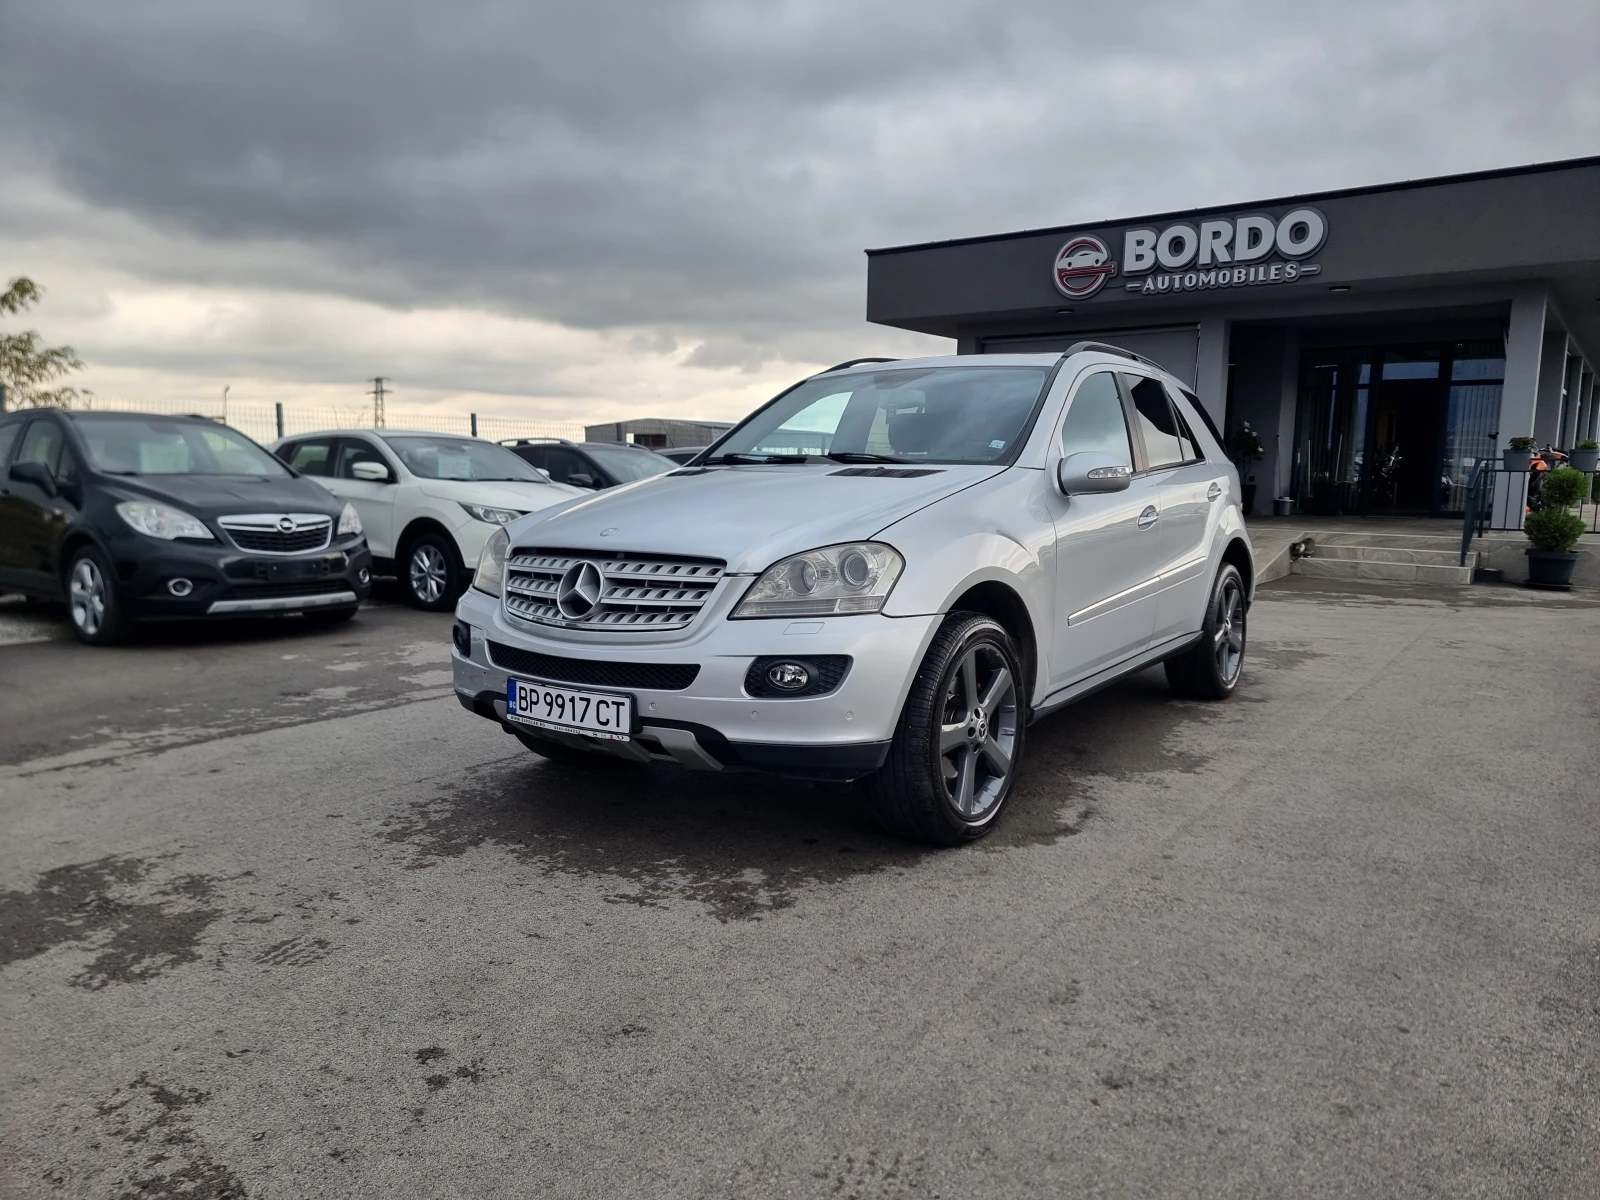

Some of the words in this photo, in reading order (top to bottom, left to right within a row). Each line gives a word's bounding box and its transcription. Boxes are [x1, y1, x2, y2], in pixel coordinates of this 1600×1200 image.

[1123, 209, 1324, 272] BORDO
[1143, 264, 1297, 293] AUTOMOBILES
[518, 686, 540, 713] BP
[543, 692, 591, 723] 9917
[596, 700, 625, 728] CT
